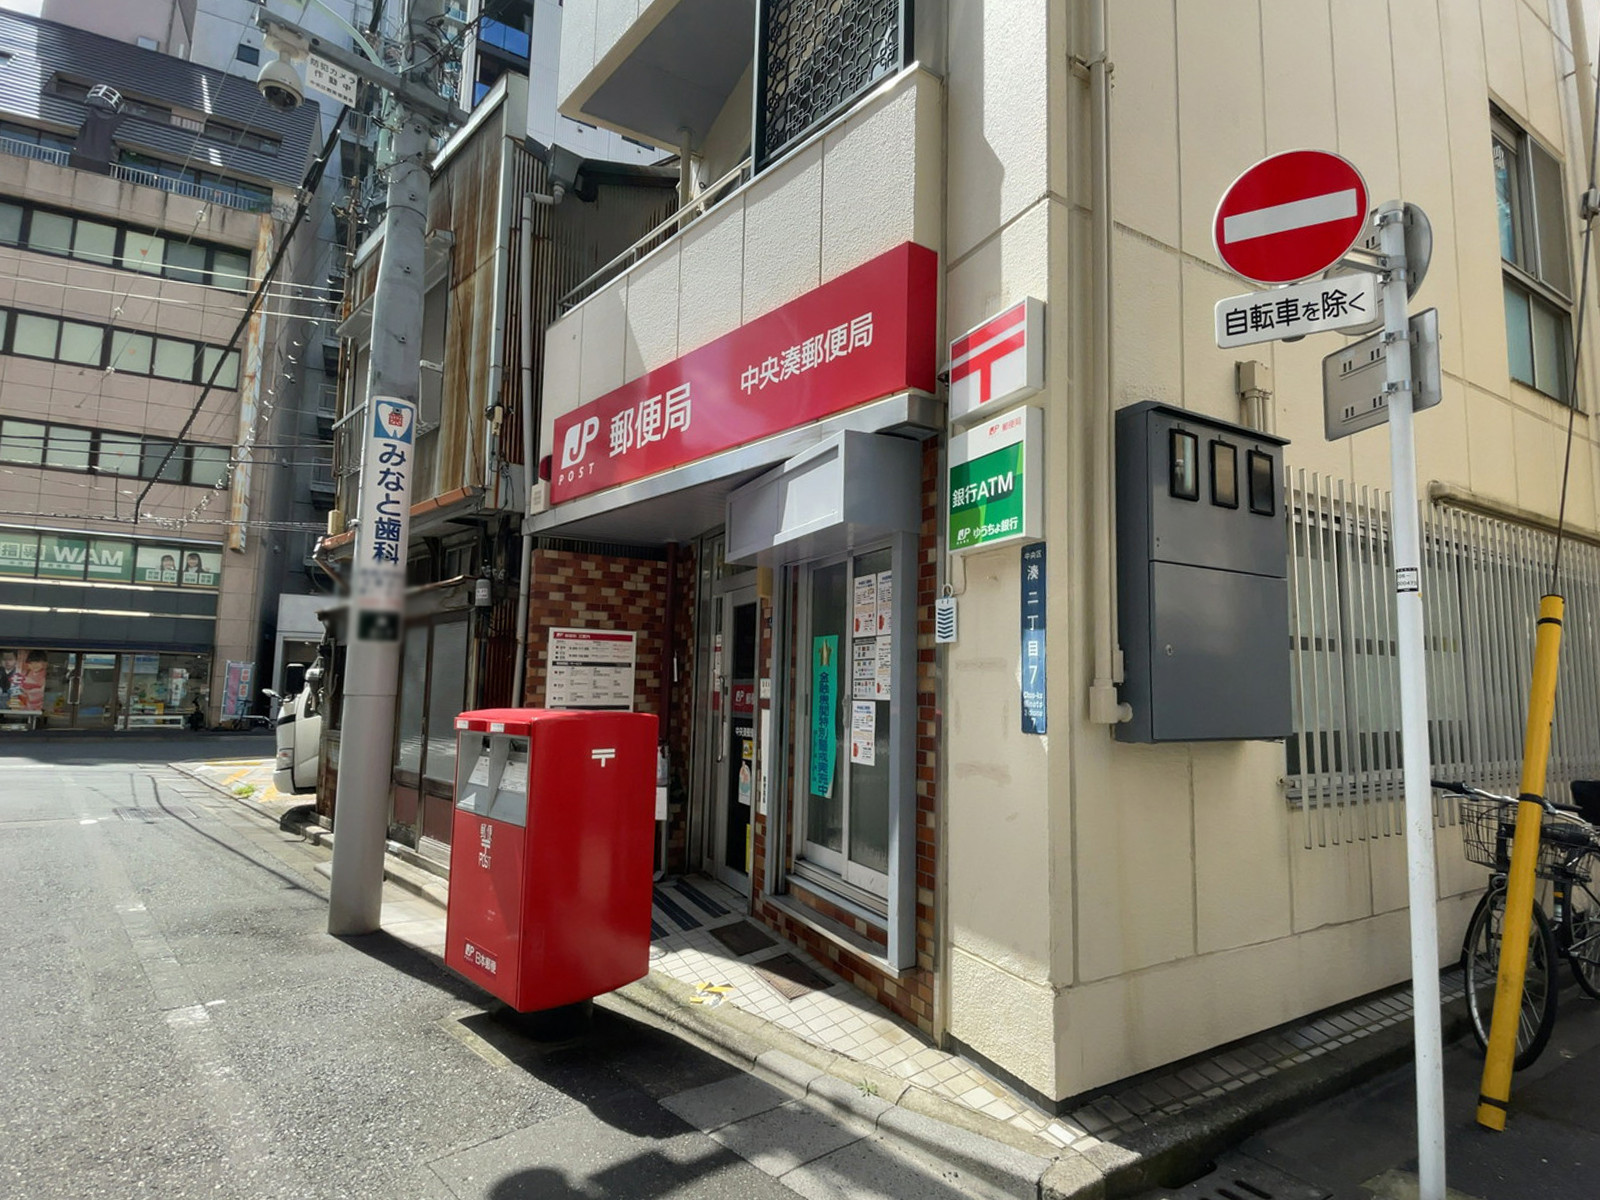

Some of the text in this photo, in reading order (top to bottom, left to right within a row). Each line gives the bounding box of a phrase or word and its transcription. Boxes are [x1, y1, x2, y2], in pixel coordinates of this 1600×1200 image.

[1225, 288, 1366, 337] 自転車を除く
[740, 311, 873, 395] 中央湊郵便局
[608, 381, 692, 458] 郵便局
[557, 462, 596, 486] POST
[952, 470, 1014, 508] 銀行ATM
[371, 442, 407, 565] みなと歯科
[972, 516, 1019, 540] ゆうちょ銀行
[53, 545, 124, 567] WAM
[1024, 549, 1043, 560] 中央区
[477, 852, 492, 869] POST
[475, 950, 497, 975] 日本郵便
